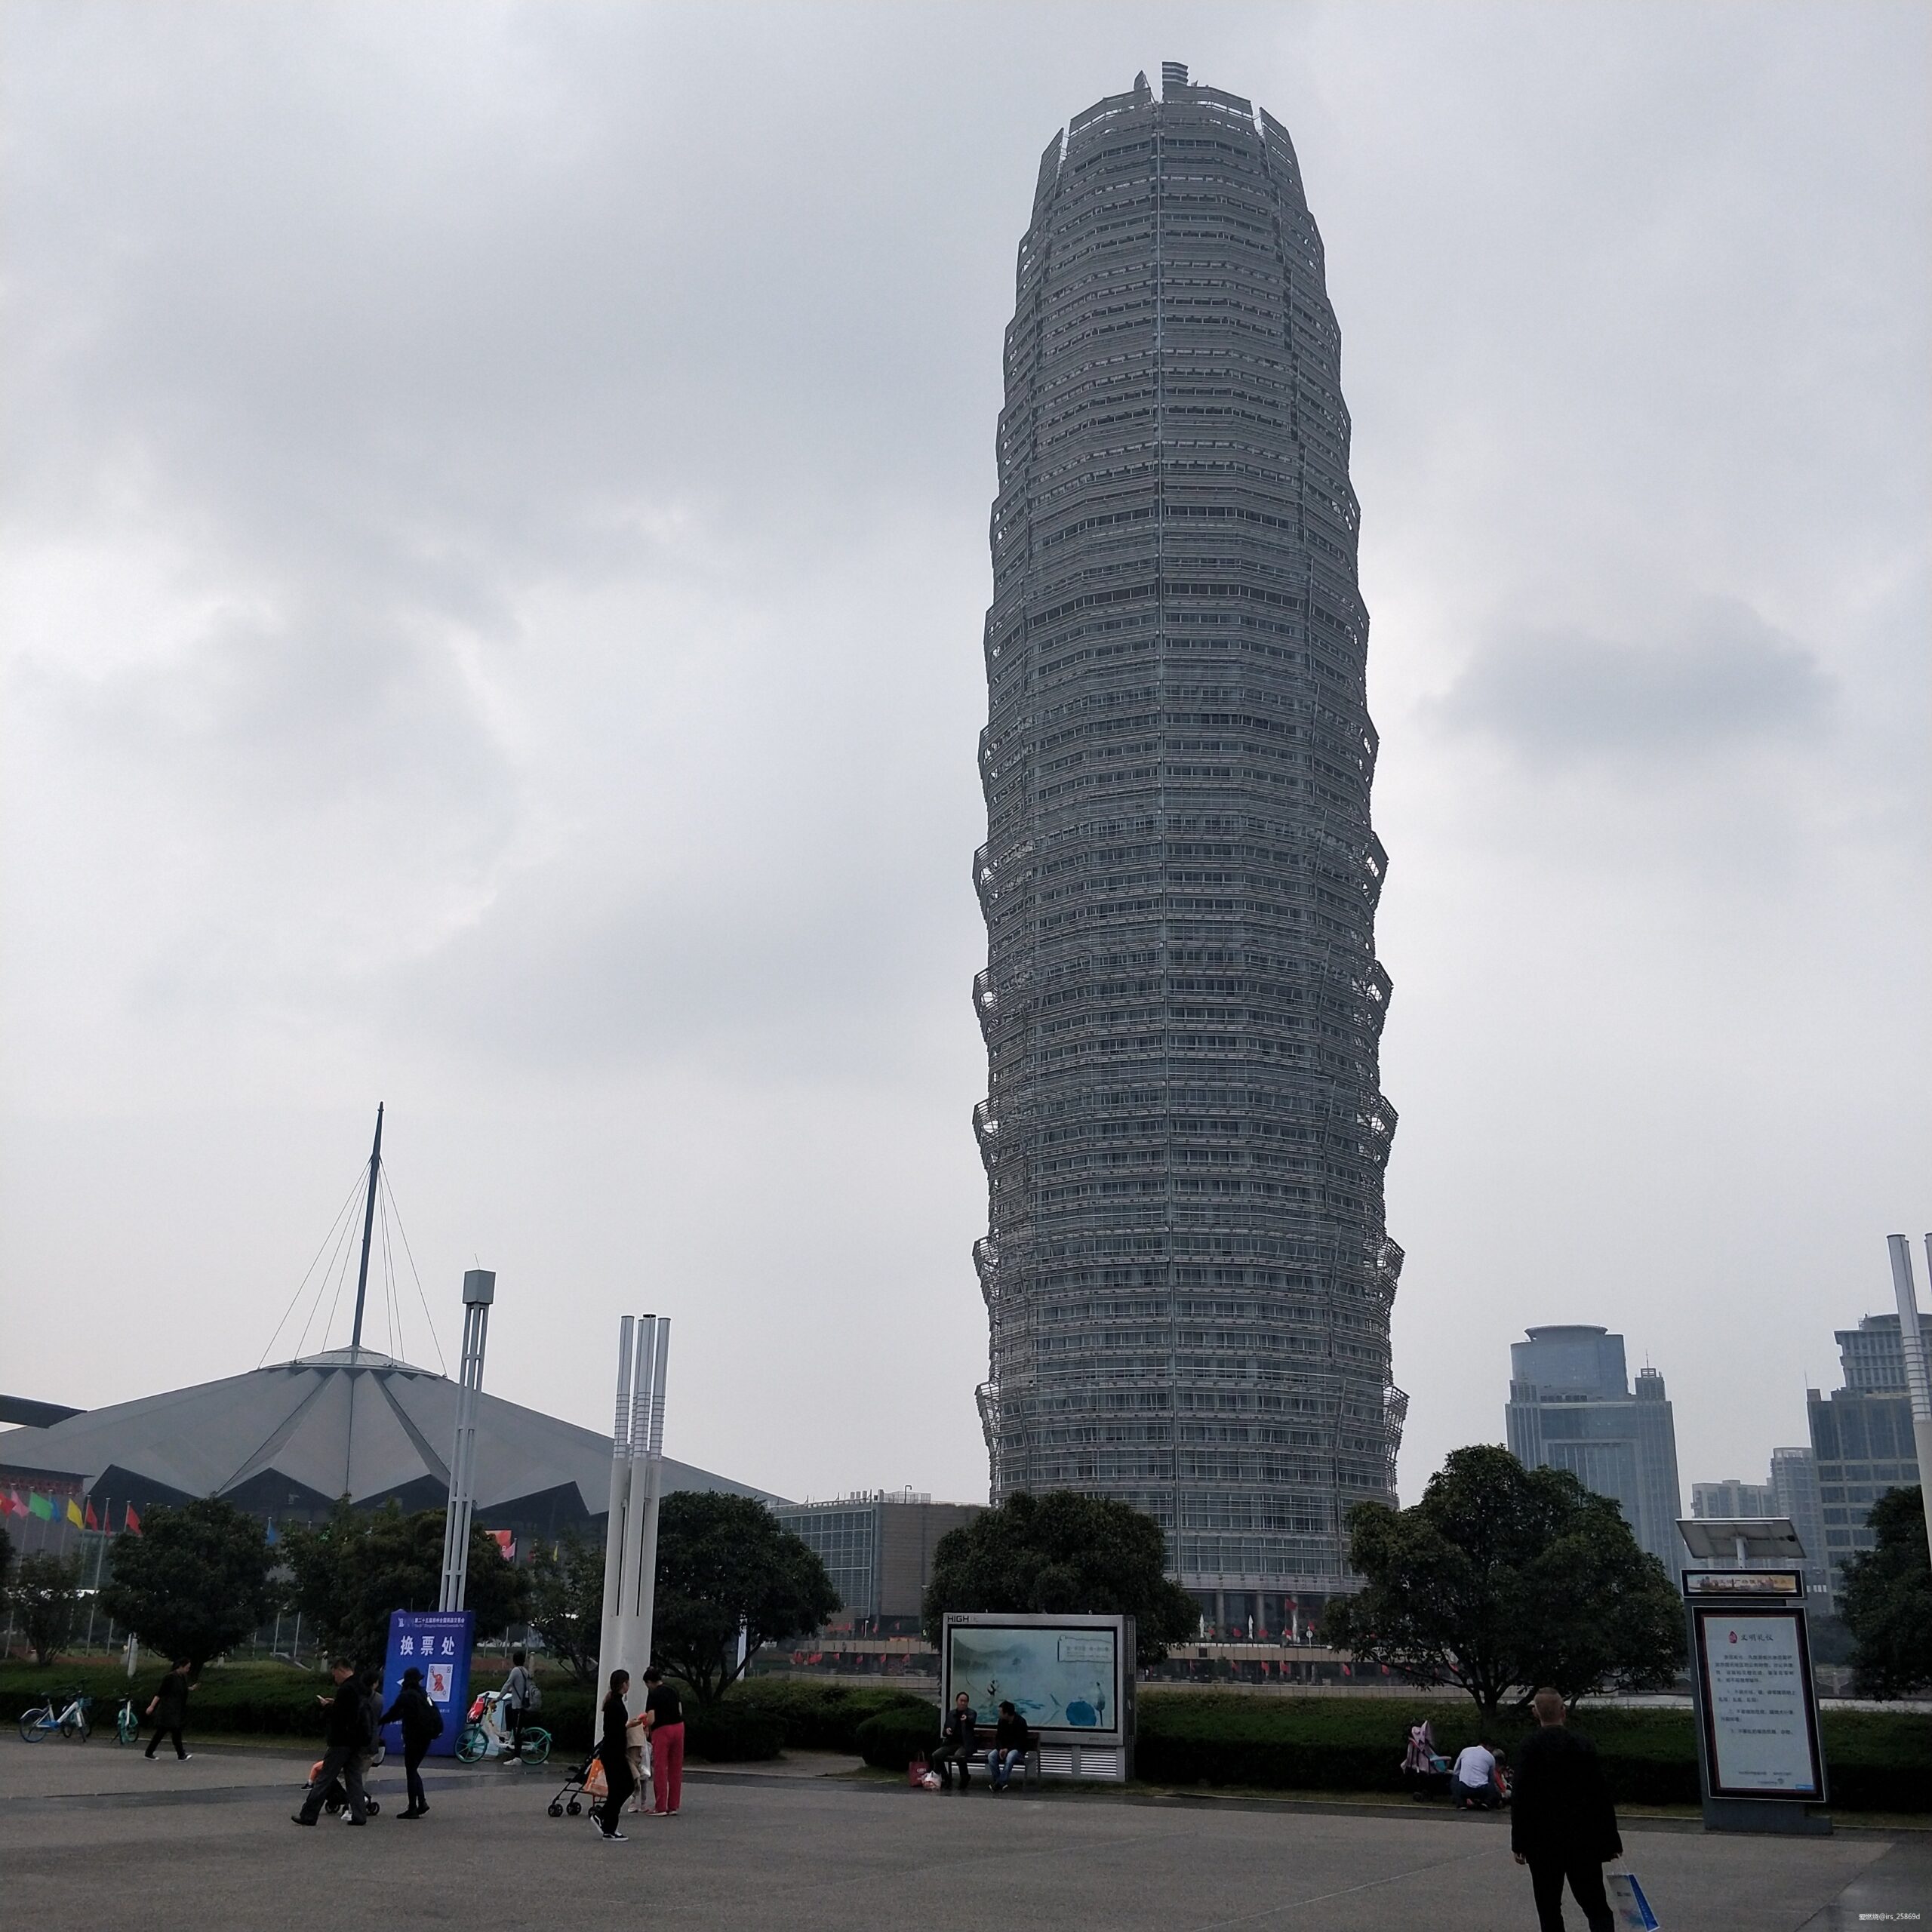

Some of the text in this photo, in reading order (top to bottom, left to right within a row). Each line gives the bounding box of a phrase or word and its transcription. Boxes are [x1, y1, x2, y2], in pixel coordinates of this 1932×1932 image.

[1740, 1633, 1774, 1642] 文明礼仪
[399, 1635, 455, 1657] 换票处
